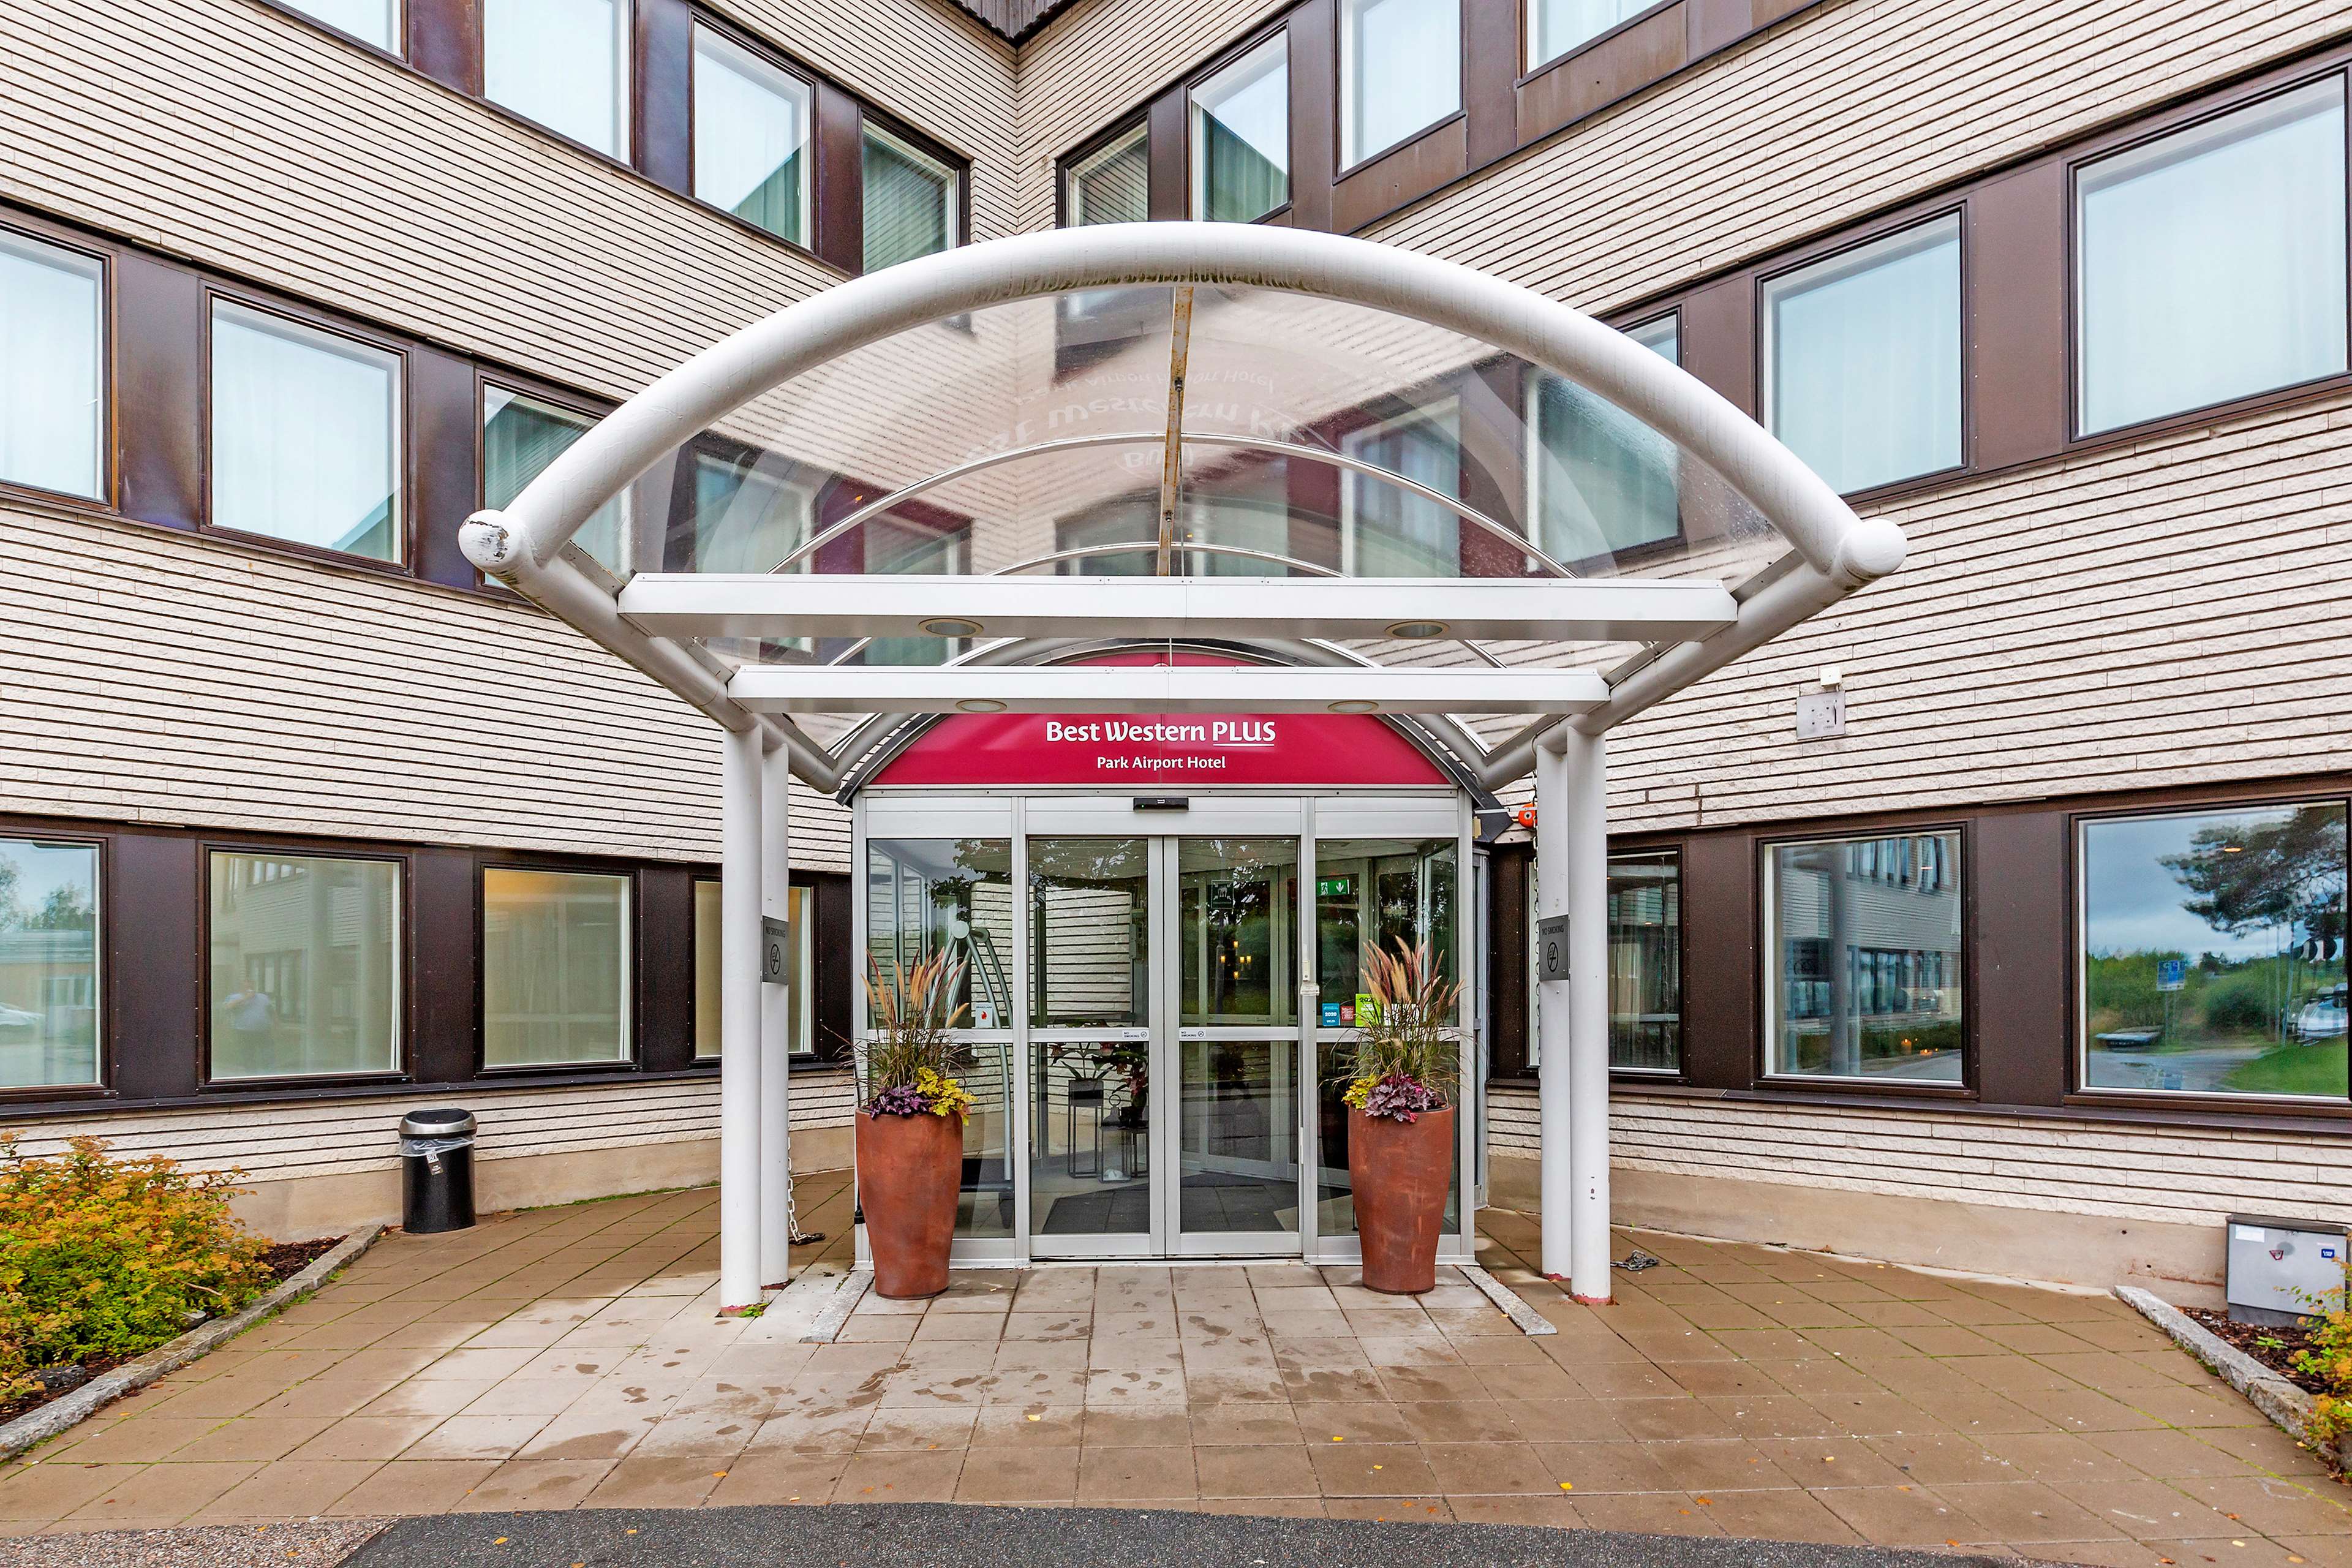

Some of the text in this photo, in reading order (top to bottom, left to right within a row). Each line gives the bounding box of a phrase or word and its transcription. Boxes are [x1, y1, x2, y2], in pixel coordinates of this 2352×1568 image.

[1047, 721, 1276, 742] Best Western PLUS
[1097, 756, 1226, 771] Park Airport Hotel
